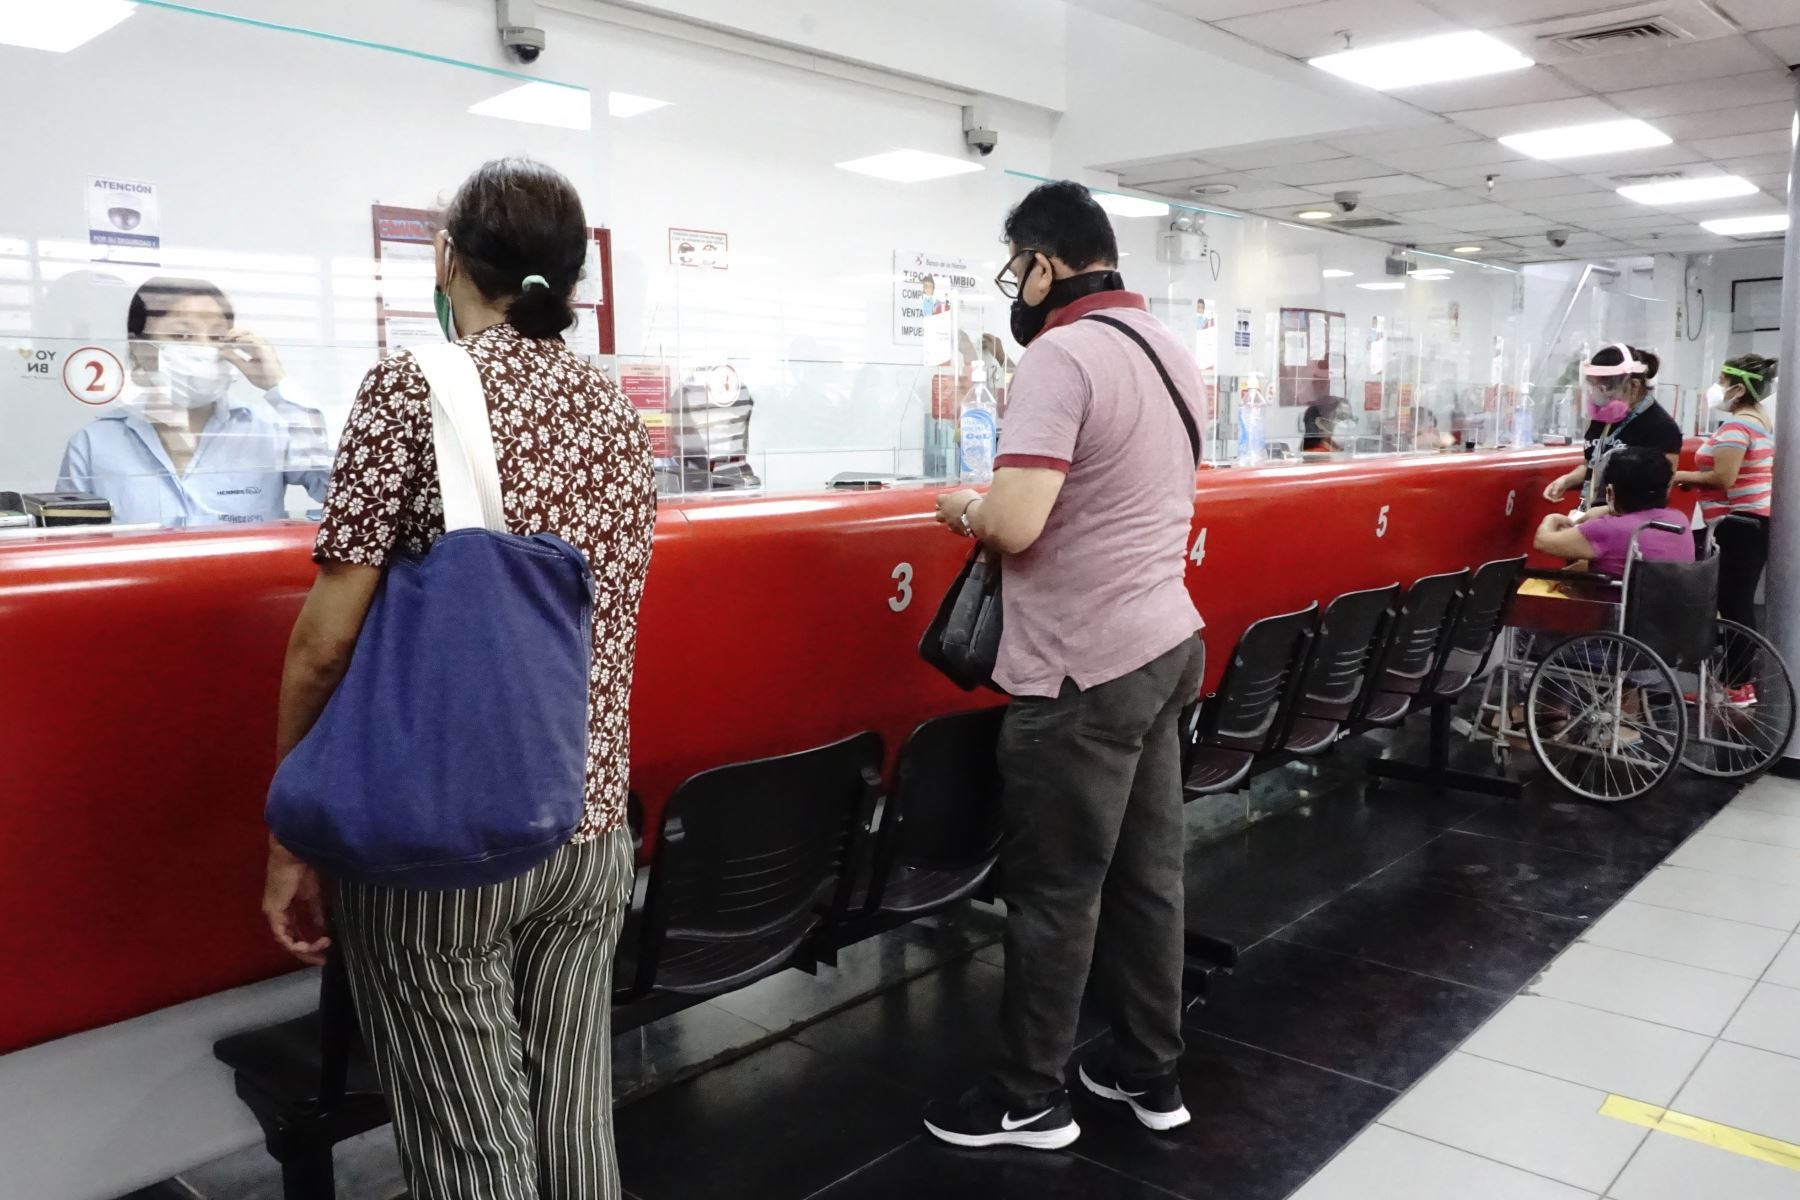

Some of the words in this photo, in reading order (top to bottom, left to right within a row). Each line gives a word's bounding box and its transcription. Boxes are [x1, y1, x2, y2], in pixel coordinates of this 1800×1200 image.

[94, 180, 152, 193] ATENCIÓN
[902, 289, 924, 299] COMP
[902, 307, 924, 318] VENTA
[901, 325, 924, 337] IMPUE
[85, 361, 106, 391] 2
[1505, 489, 1516, 516] 6
[1376, 505, 1390, 538] 5
[1190, 527, 1208, 567] 4
[888, 562, 913, 613] 3
